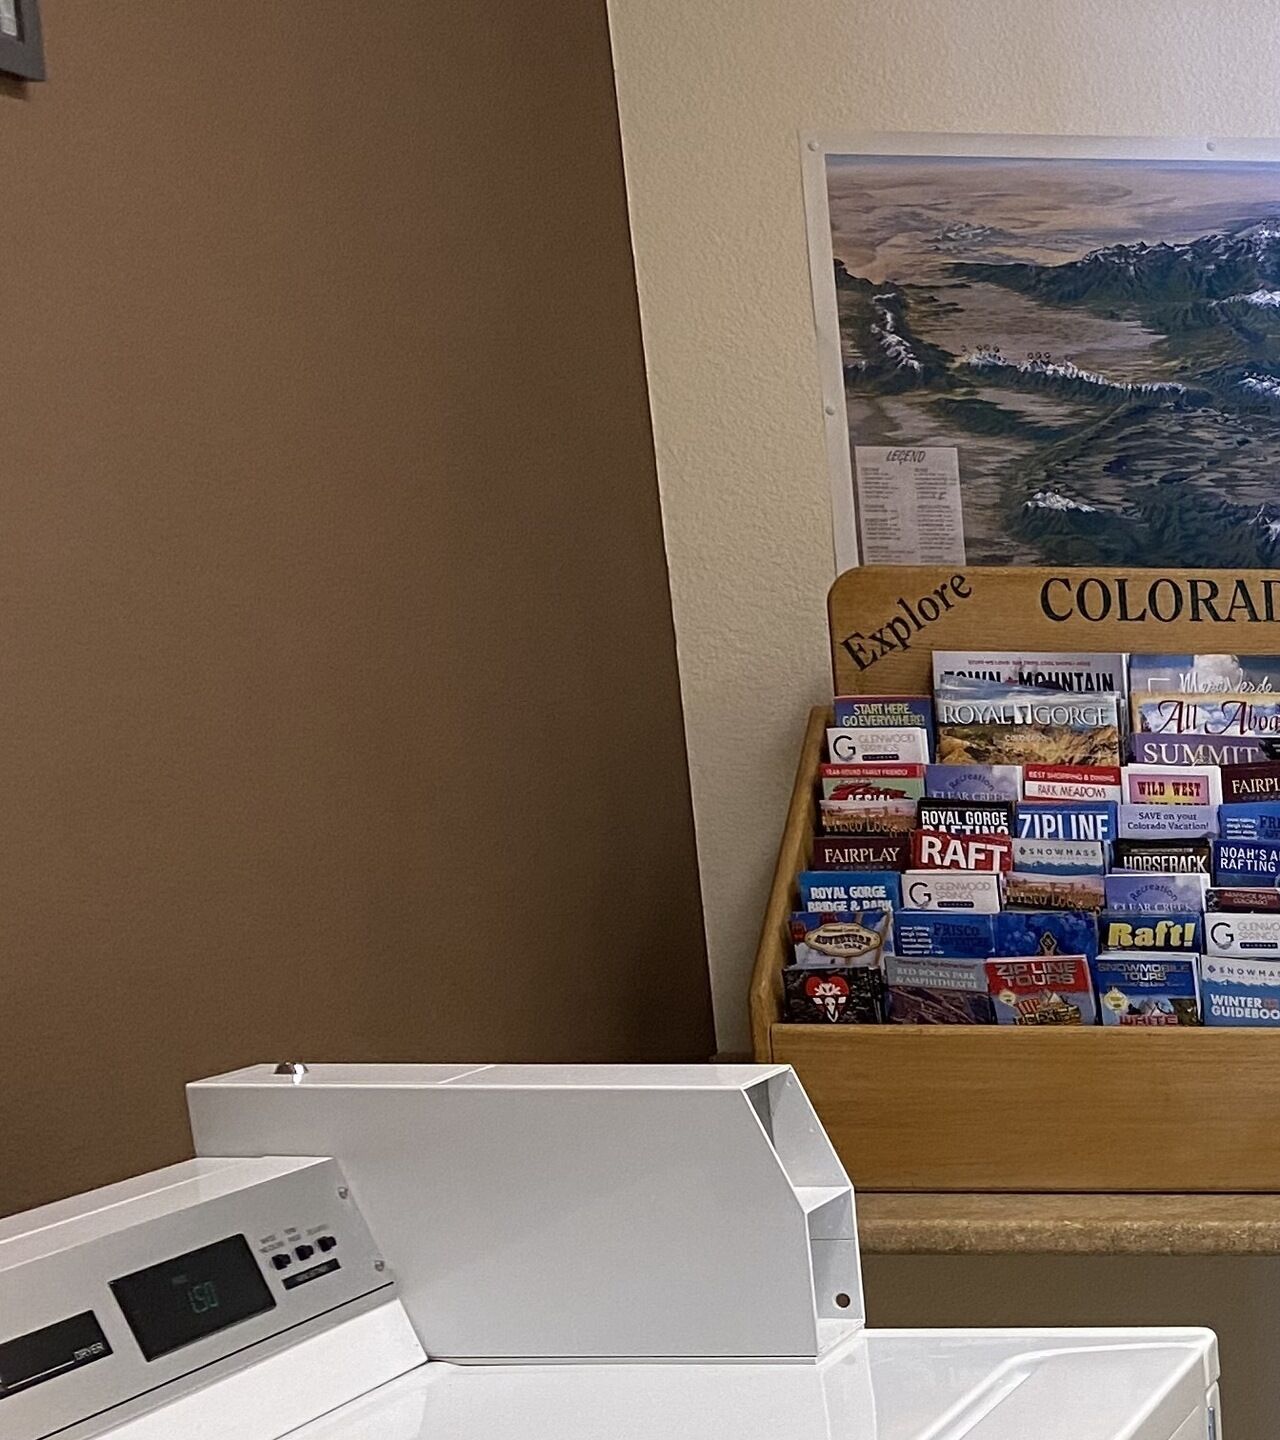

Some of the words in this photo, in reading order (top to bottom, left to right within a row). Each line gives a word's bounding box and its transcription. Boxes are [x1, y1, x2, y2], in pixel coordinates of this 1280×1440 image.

[886, 450, 927, 463] LEGEND
[840, 573, 972, 671] Explore
[853, 703, 883, 715] START
[943, 704, 1012, 725] ROYAL
[1034, 705, 1109, 726] GORGE
[842, 715, 858, 726] GO
[1157, 700, 1198, 734] All
[858, 734, 915, 743] GLENWOOD
[1143, 742, 1260, 765] SUMMIT
[1028, 770, 1046, 779] BEST
[1037, 784, 1058, 796] PARK
[1060, 785, 1107, 798] MEADOWS
[1137, 781, 1165, 796] WILD
[1172, 781, 1202, 797] WEST
[921, 810, 963, 825] ROYAL
[964, 811, 1008, 825] GORGE
[1138, 812, 1162, 820] SAVE
[1177, 814, 1197, 822] your
[1127, 822, 1167, 830] Colorado
[1169, 822, 1209, 831] Vacation!
[824, 847, 900, 863] FAIRPLAY
[920, 835, 1008, 874] RAFT
[1028, 848, 1097, 858] SNOWMASS
[1220, 846, 1267, 861] NOAH'S
[1123, 855, 1208, 873] HORSEBACK
[1220, 859, 1276, 873] RAFTING
[810, 886, 848, 899] ROYAL
[849, 885, 886, 898] GORGE
[934, 881, 991, 891] GLENWOOD
[1129, 884, 1178, 902] Recreation
[935, 891, 973, 900] SPRINGS
[807, 900, 848, 912] BRIDGE
[850, 900, 860, 911] &
[1107, 920, 1196, 947] Raft!
[1238, 932, 1279, 940] SPRINGS
[994, 963, 1030, 977] ZIP
[1032, 962, 1078, 974] LINE
[1099, 963, 1191, 973] SNOWMOBILE
[1001, 973, 1075, 987] TOURS
[1122, 972, 1167, 981] TOURS
[1210, 994, 1262, 1008] WINTER
